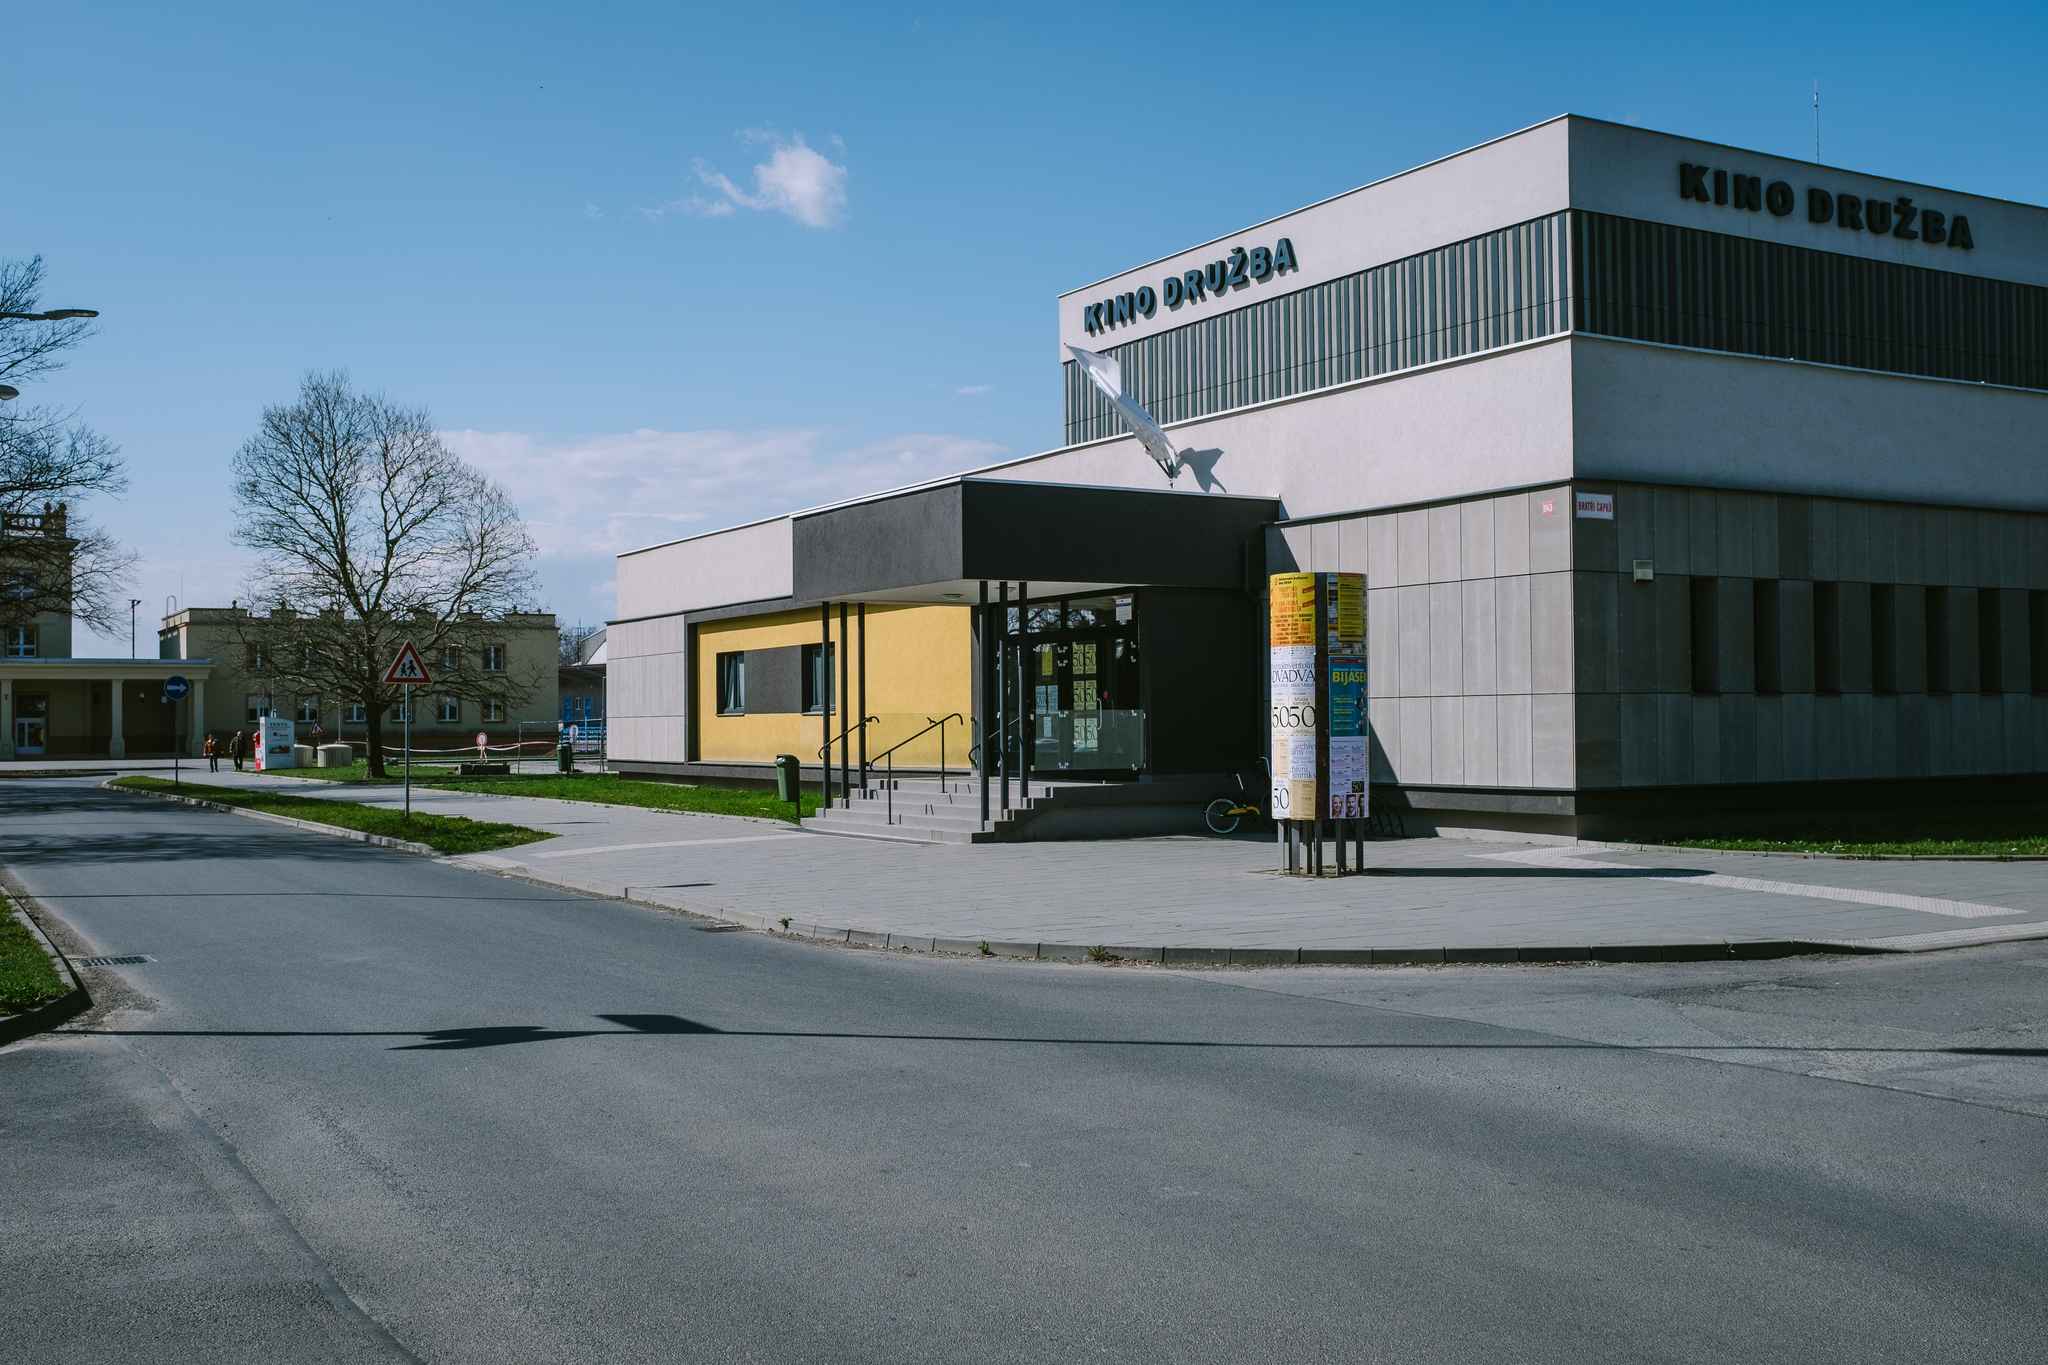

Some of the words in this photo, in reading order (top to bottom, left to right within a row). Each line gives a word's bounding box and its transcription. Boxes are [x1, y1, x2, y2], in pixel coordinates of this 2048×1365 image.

[1679, 163, 1794, 217] KINO
[1807, 188, 1974, 249] DRUŽBA
[1084, 286, 1155, 336] KINO
[1163, 238, 1298, 308] DRUŽBA
[1272, 788, 1289, 809] 50
